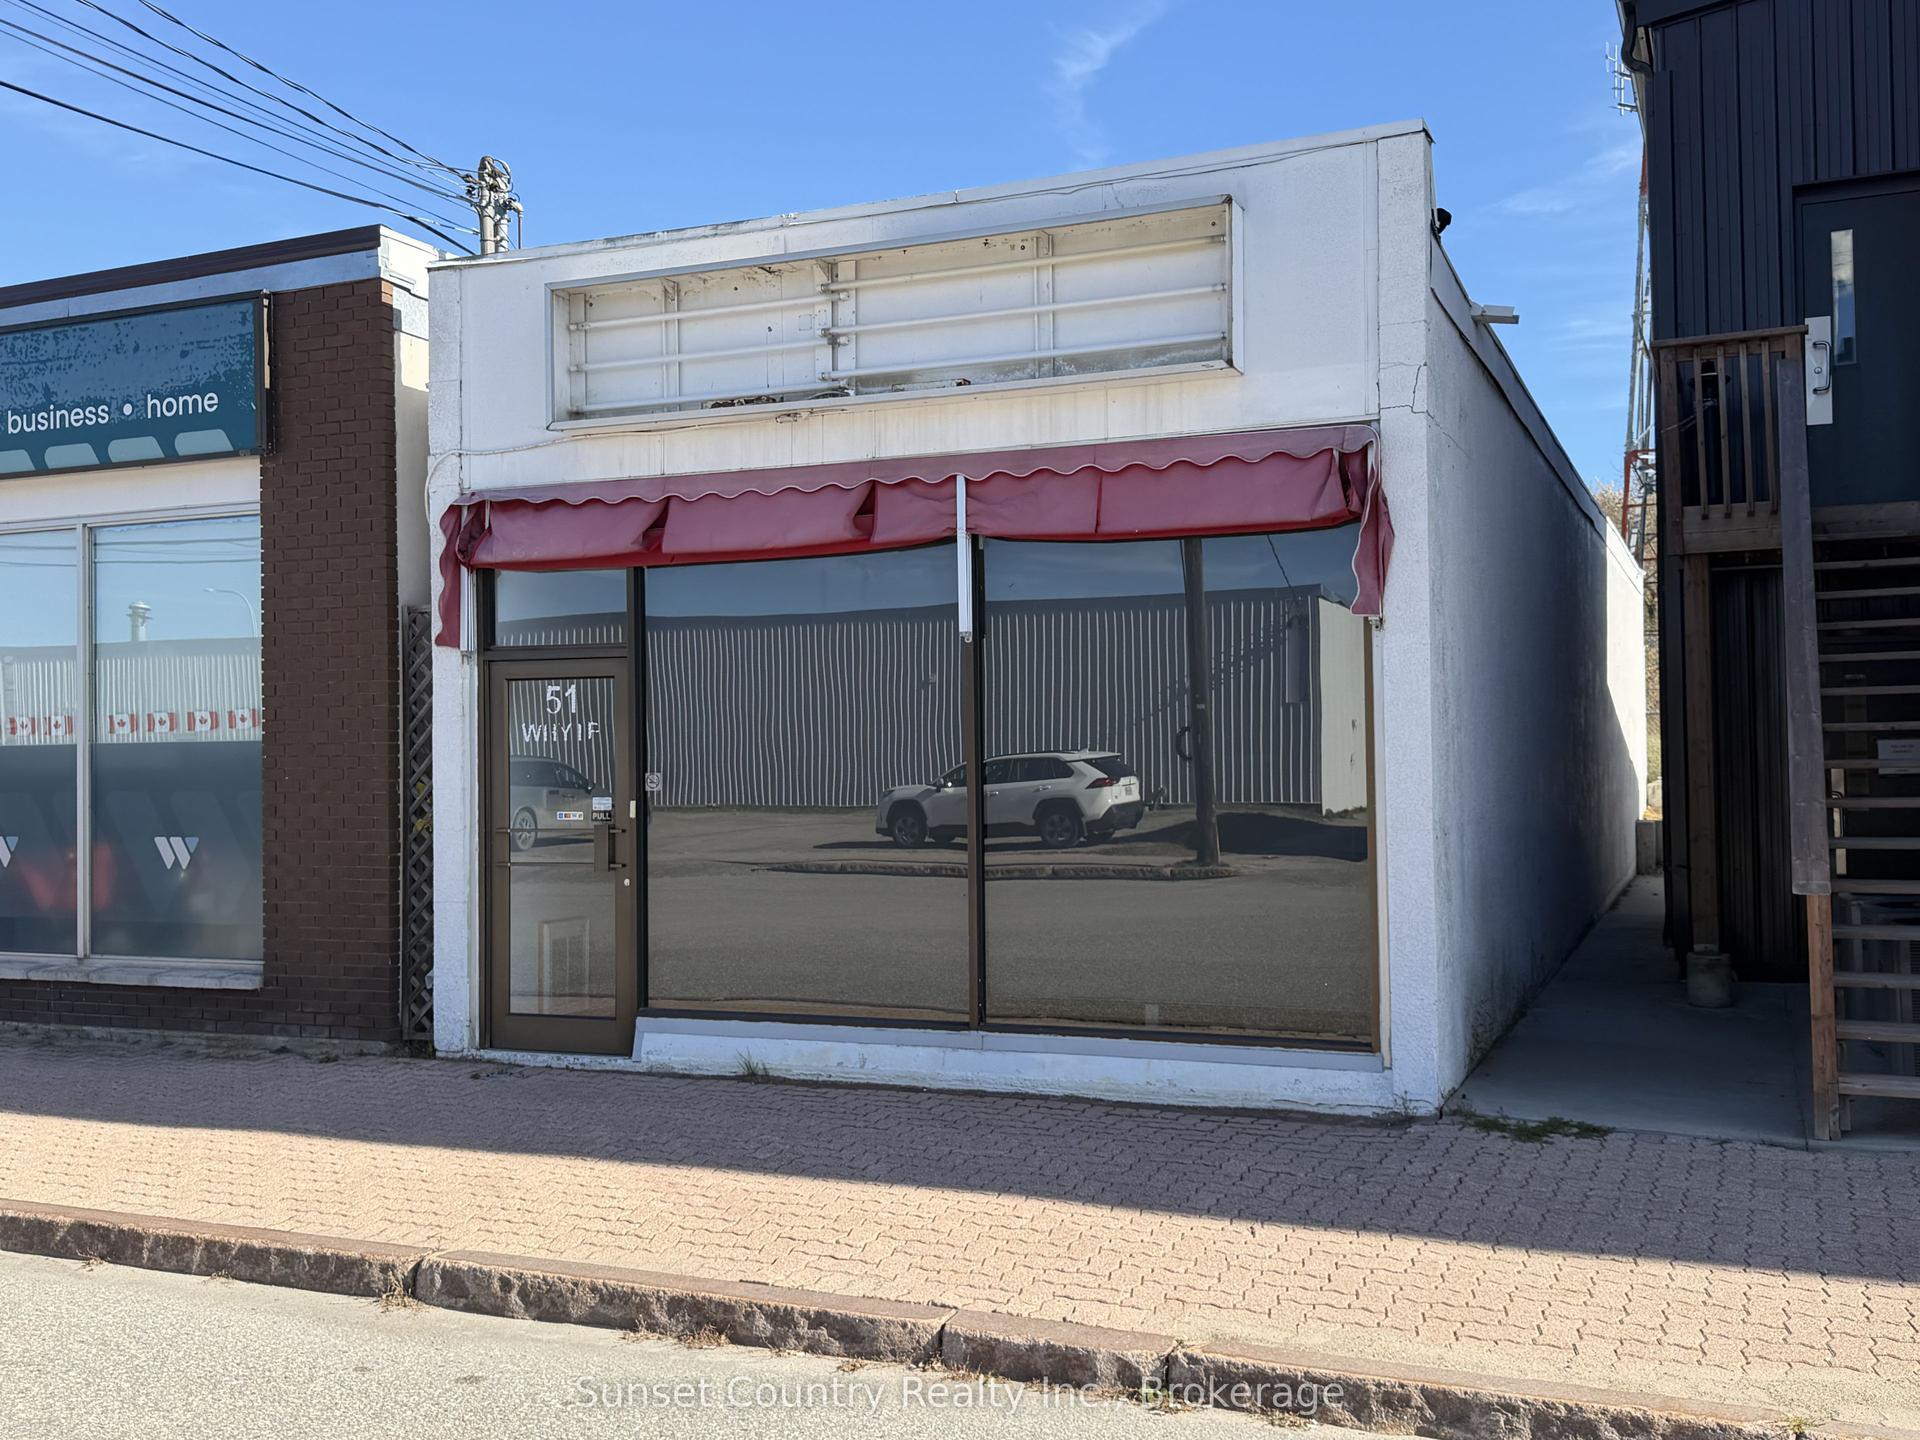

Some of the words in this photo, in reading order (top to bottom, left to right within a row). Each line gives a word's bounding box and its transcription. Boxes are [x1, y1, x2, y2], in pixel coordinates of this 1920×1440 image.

[7, 404, 110, 434] business
[147, 391, 219, 419] home
[546, 684, 577, 714] 51
[592, 811, 611, 820] PULL
